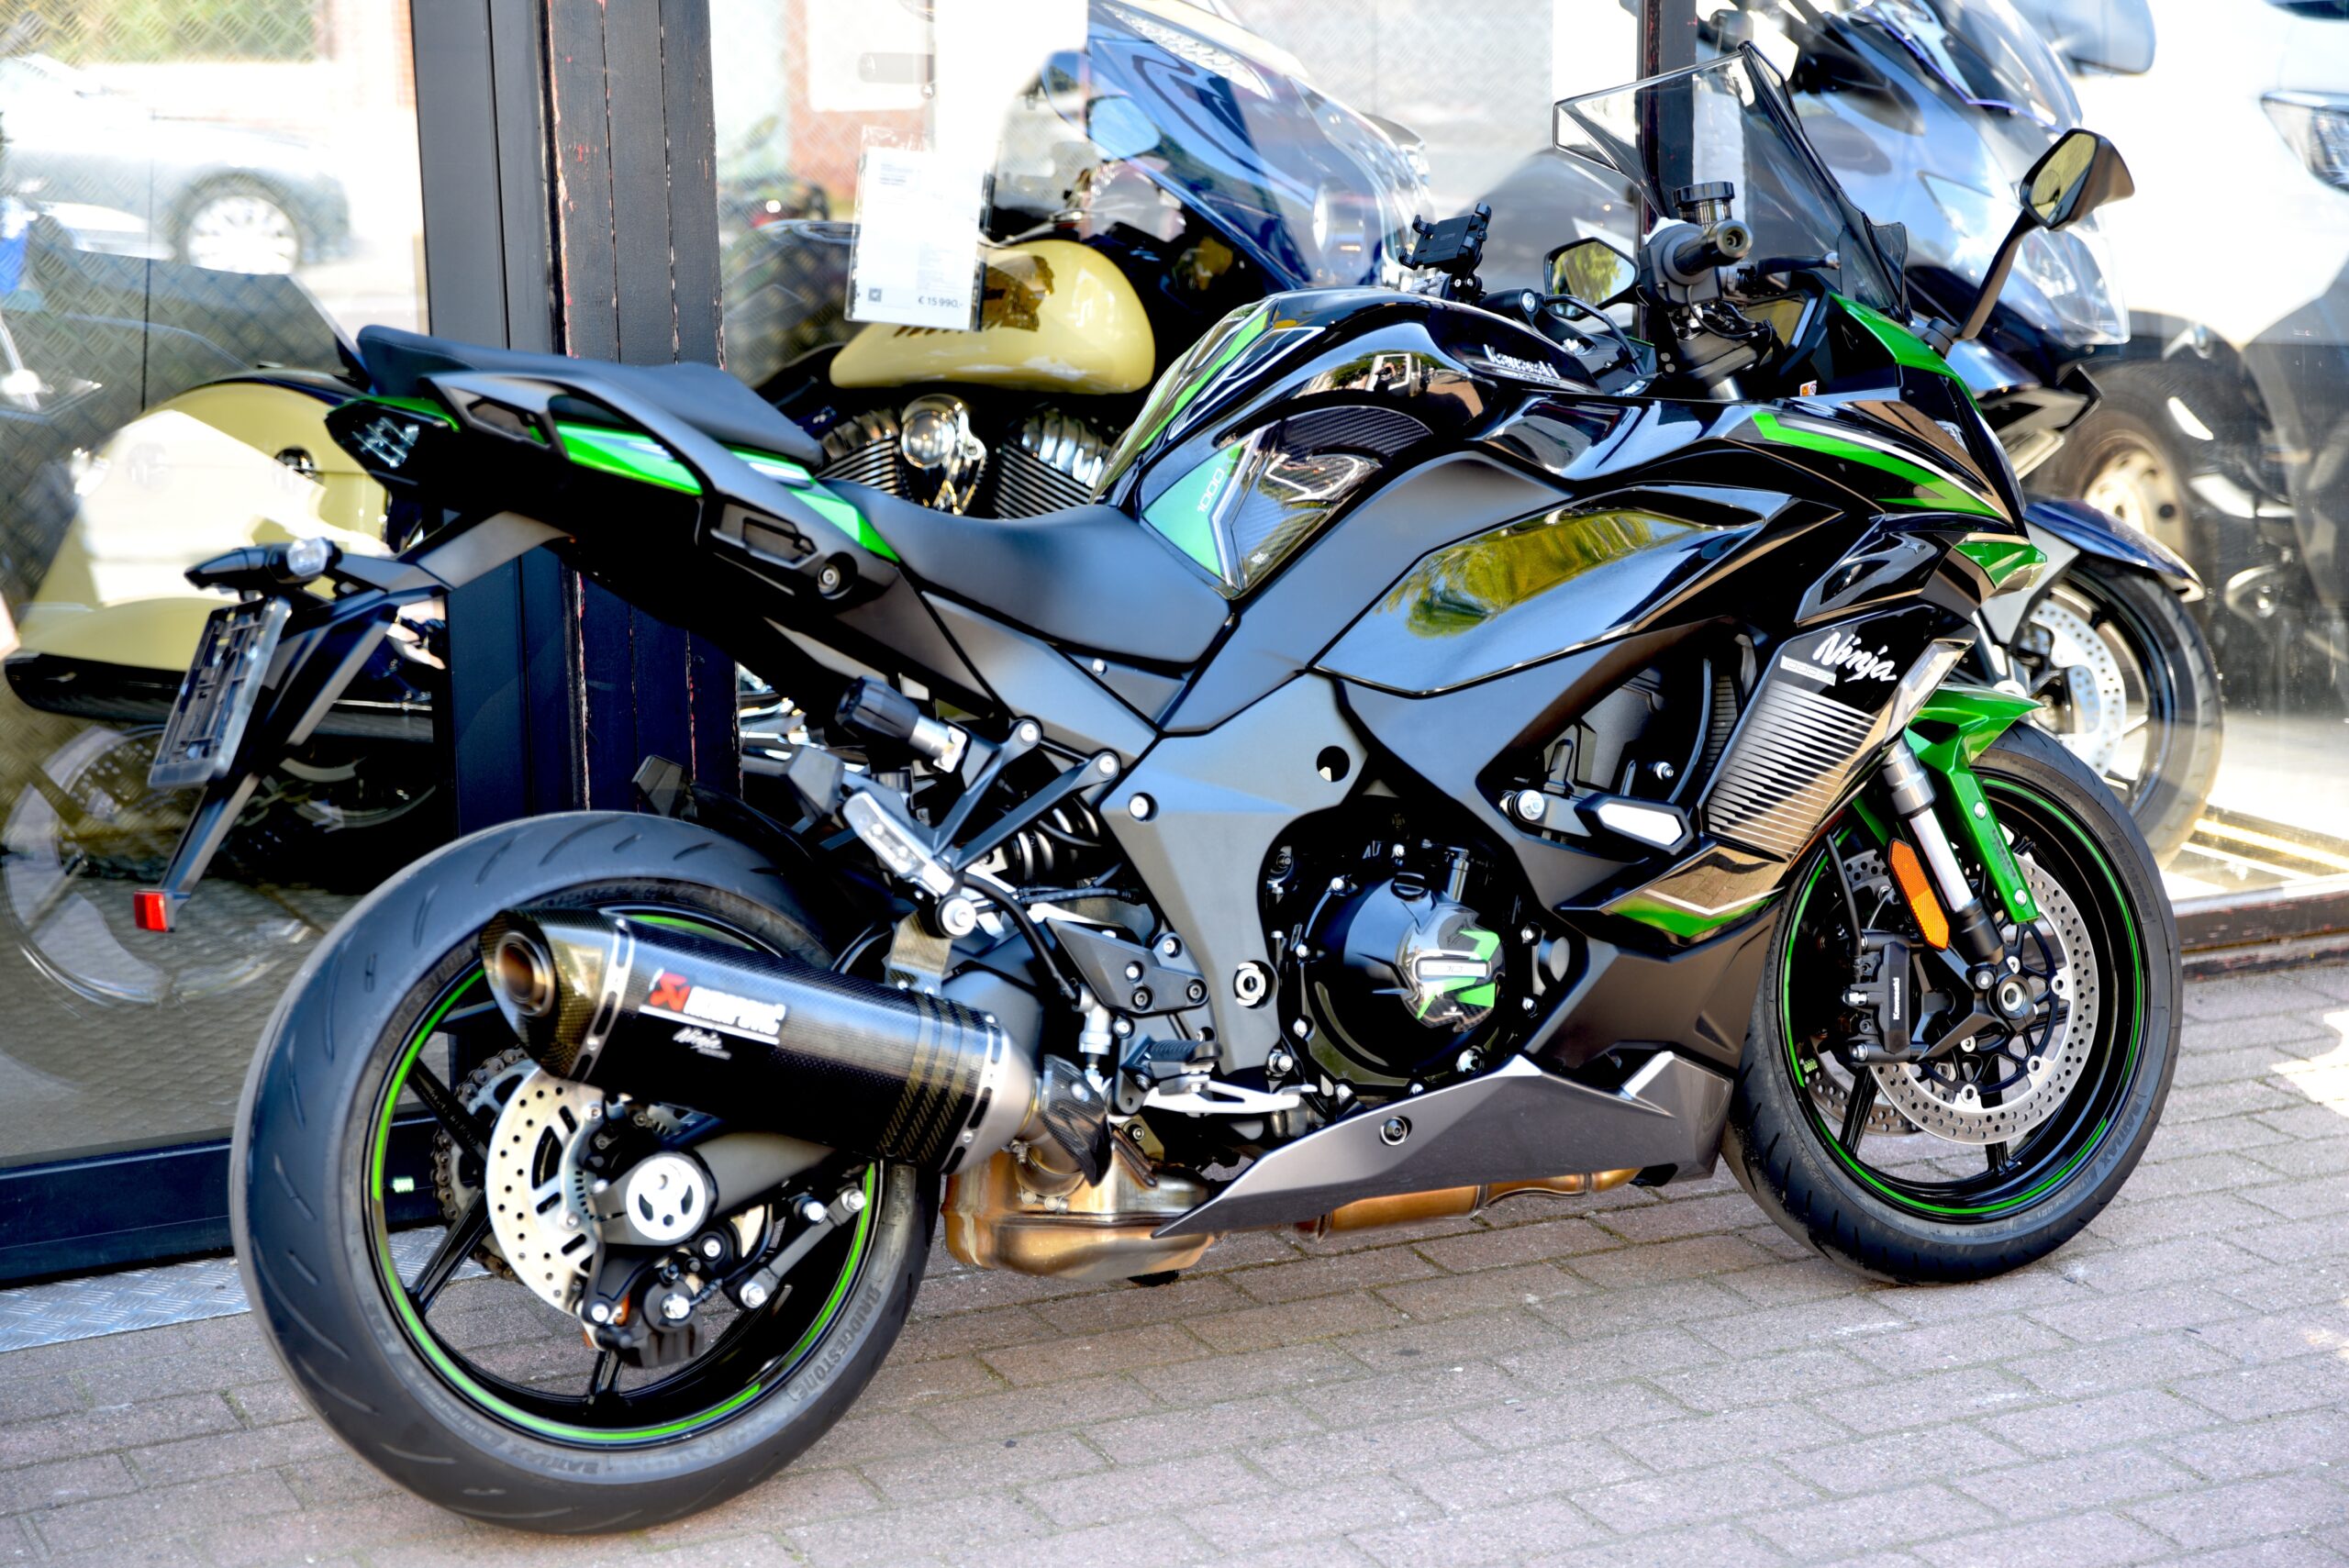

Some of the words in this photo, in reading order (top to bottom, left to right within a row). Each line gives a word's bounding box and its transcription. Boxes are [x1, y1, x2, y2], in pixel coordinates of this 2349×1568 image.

[1197, 467, 1225, 512] 1000
[1812, 631, 1898, 683] Ninja
[795, 1285, 881, 1400] BRIDGESTONE
